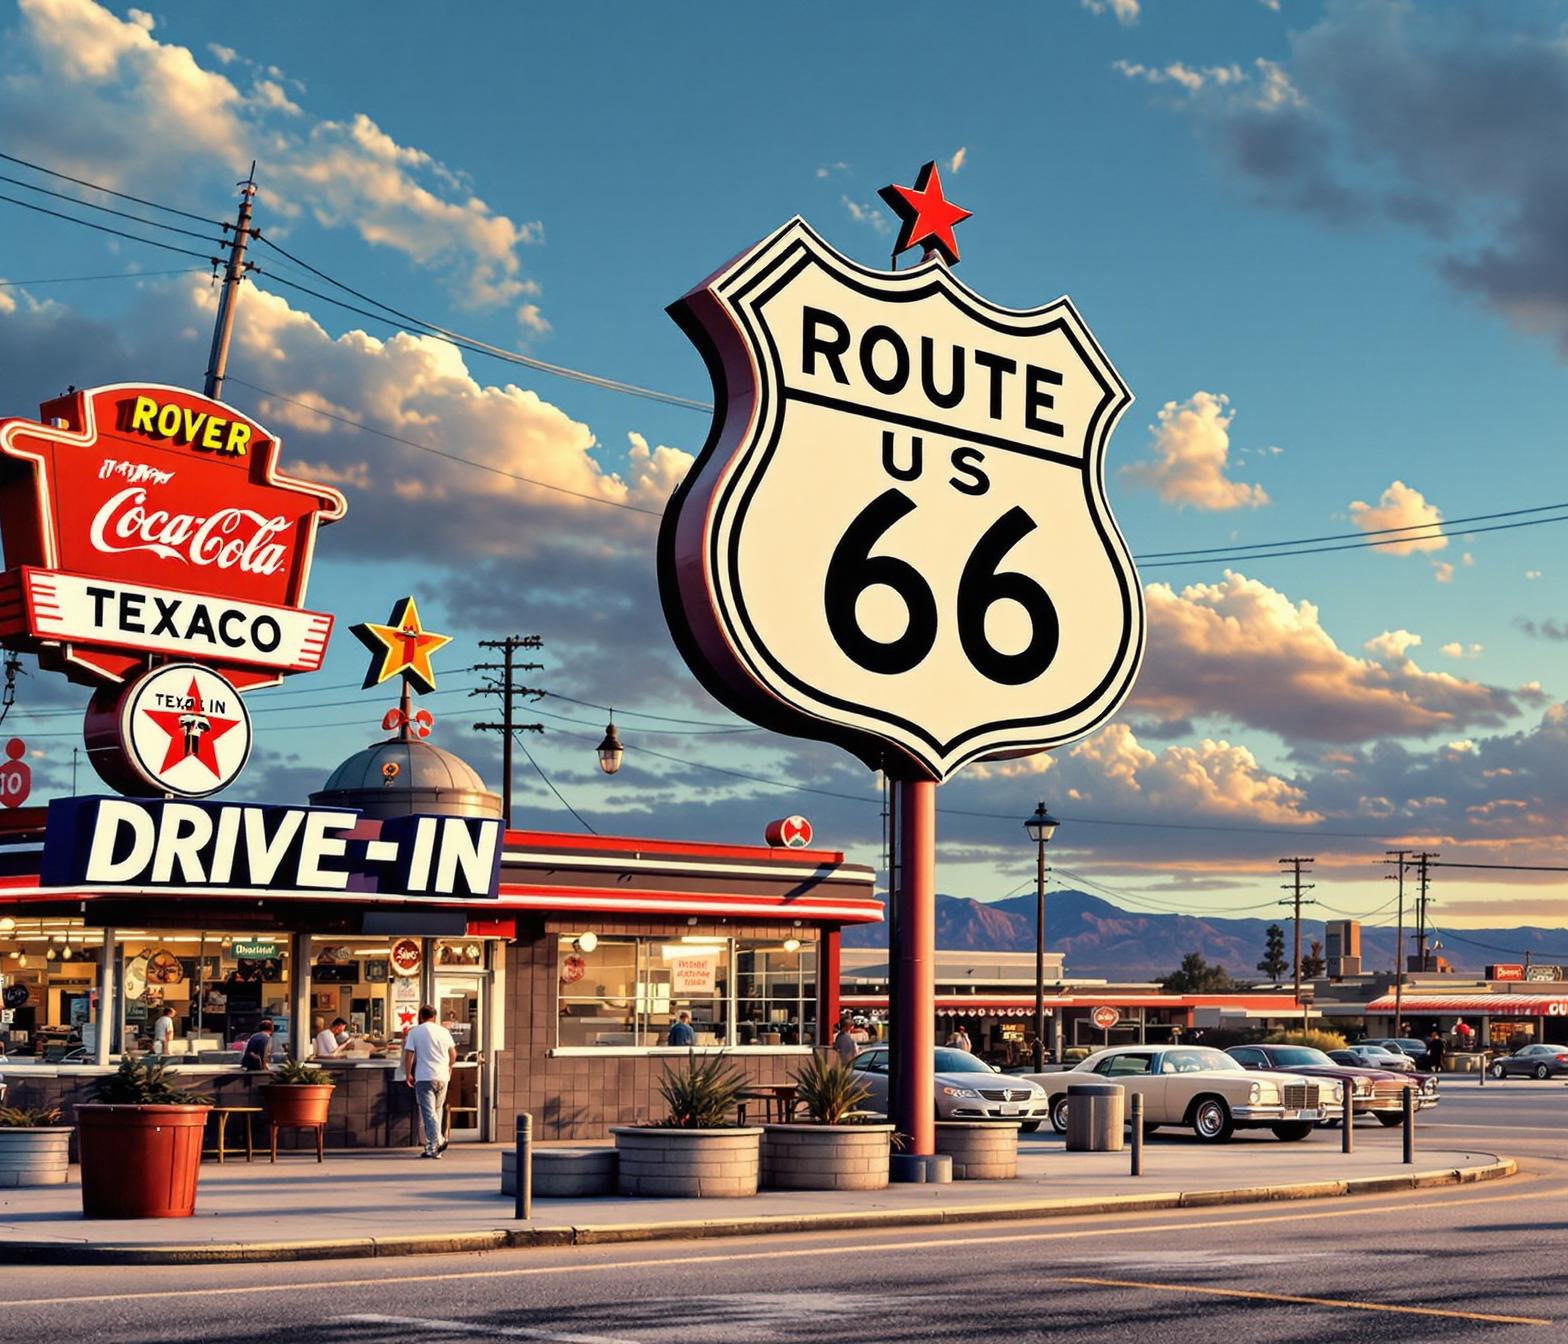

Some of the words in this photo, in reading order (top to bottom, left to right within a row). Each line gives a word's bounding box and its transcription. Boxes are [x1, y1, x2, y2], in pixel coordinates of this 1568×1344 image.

[802, 305, 1064, 438] ROUTE
[132, 395, 251, 455] ROVER
[90, 487, 293, 576] Coca-Cola
[86, 586, 282, 653] TEXACO
[825, 487, 1060, 686] 66
[85, 799, 499, 895] DRIVE-IN
